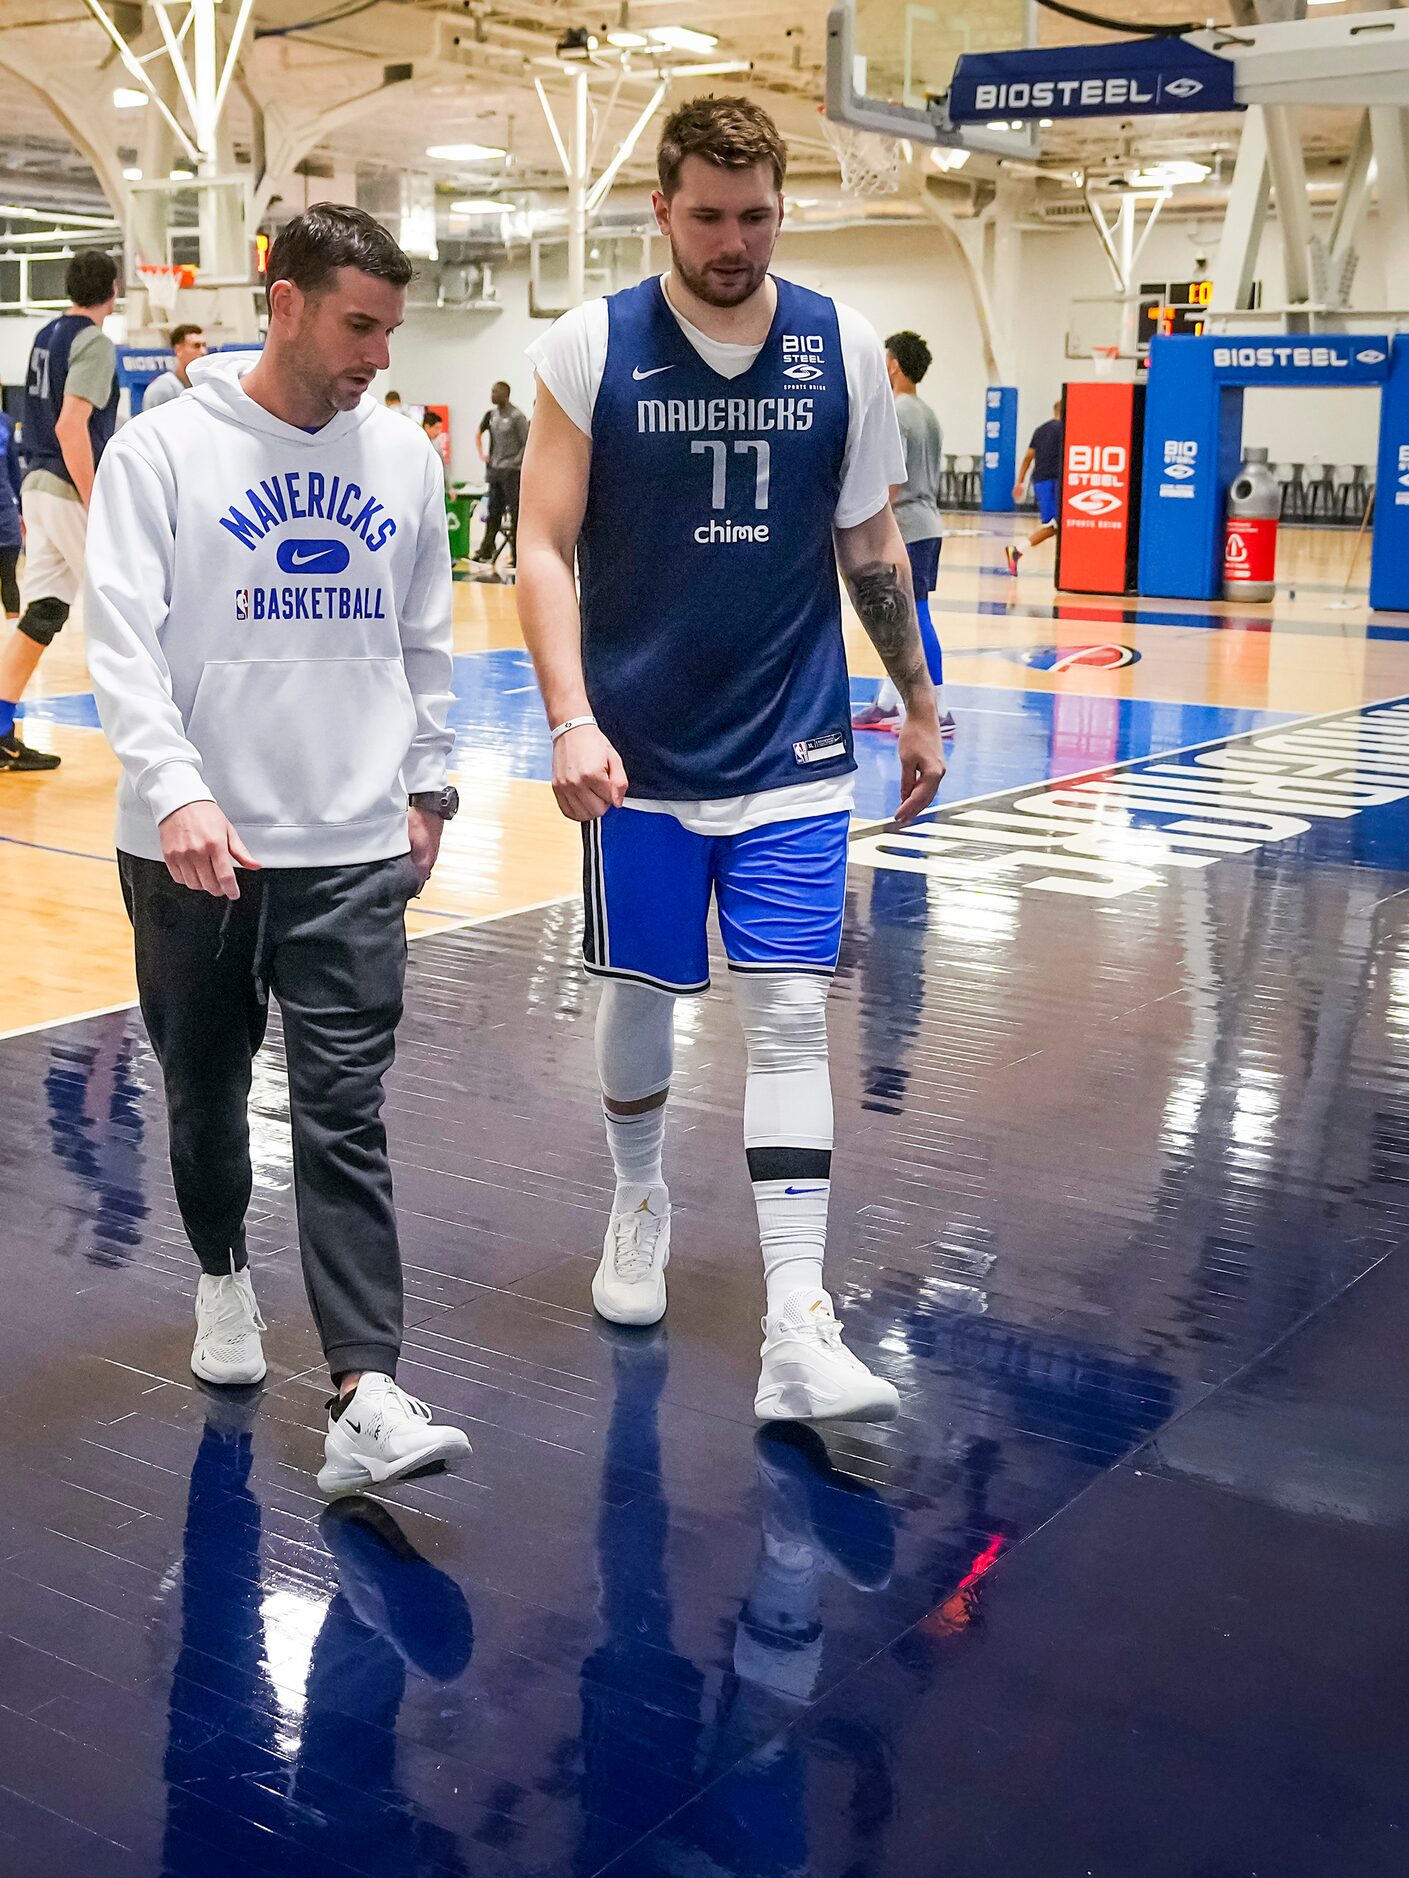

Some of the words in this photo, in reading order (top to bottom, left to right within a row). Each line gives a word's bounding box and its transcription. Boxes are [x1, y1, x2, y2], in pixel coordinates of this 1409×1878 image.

[975, 79, 1153, 110] BIOSTEEL
[782, 335, 824, 353] BIO
[783, 355, 825, 363] STEEL
[1213, 348, 1348, 367] BIOSTEEL
[637, 398, 814, 433] MAVERICKS
[1069, 445, 1127, 472] BIO
[1164, 440, 1198, 457] BIO
[690, 440, 771, 510] 77
[1068, 473, 1124, 487] STEEL
[218, 471, 397, 552] MAVERICKS
[694, 519, 770, 544] chime
[253, 587, 385, 620] BASKETBALL
